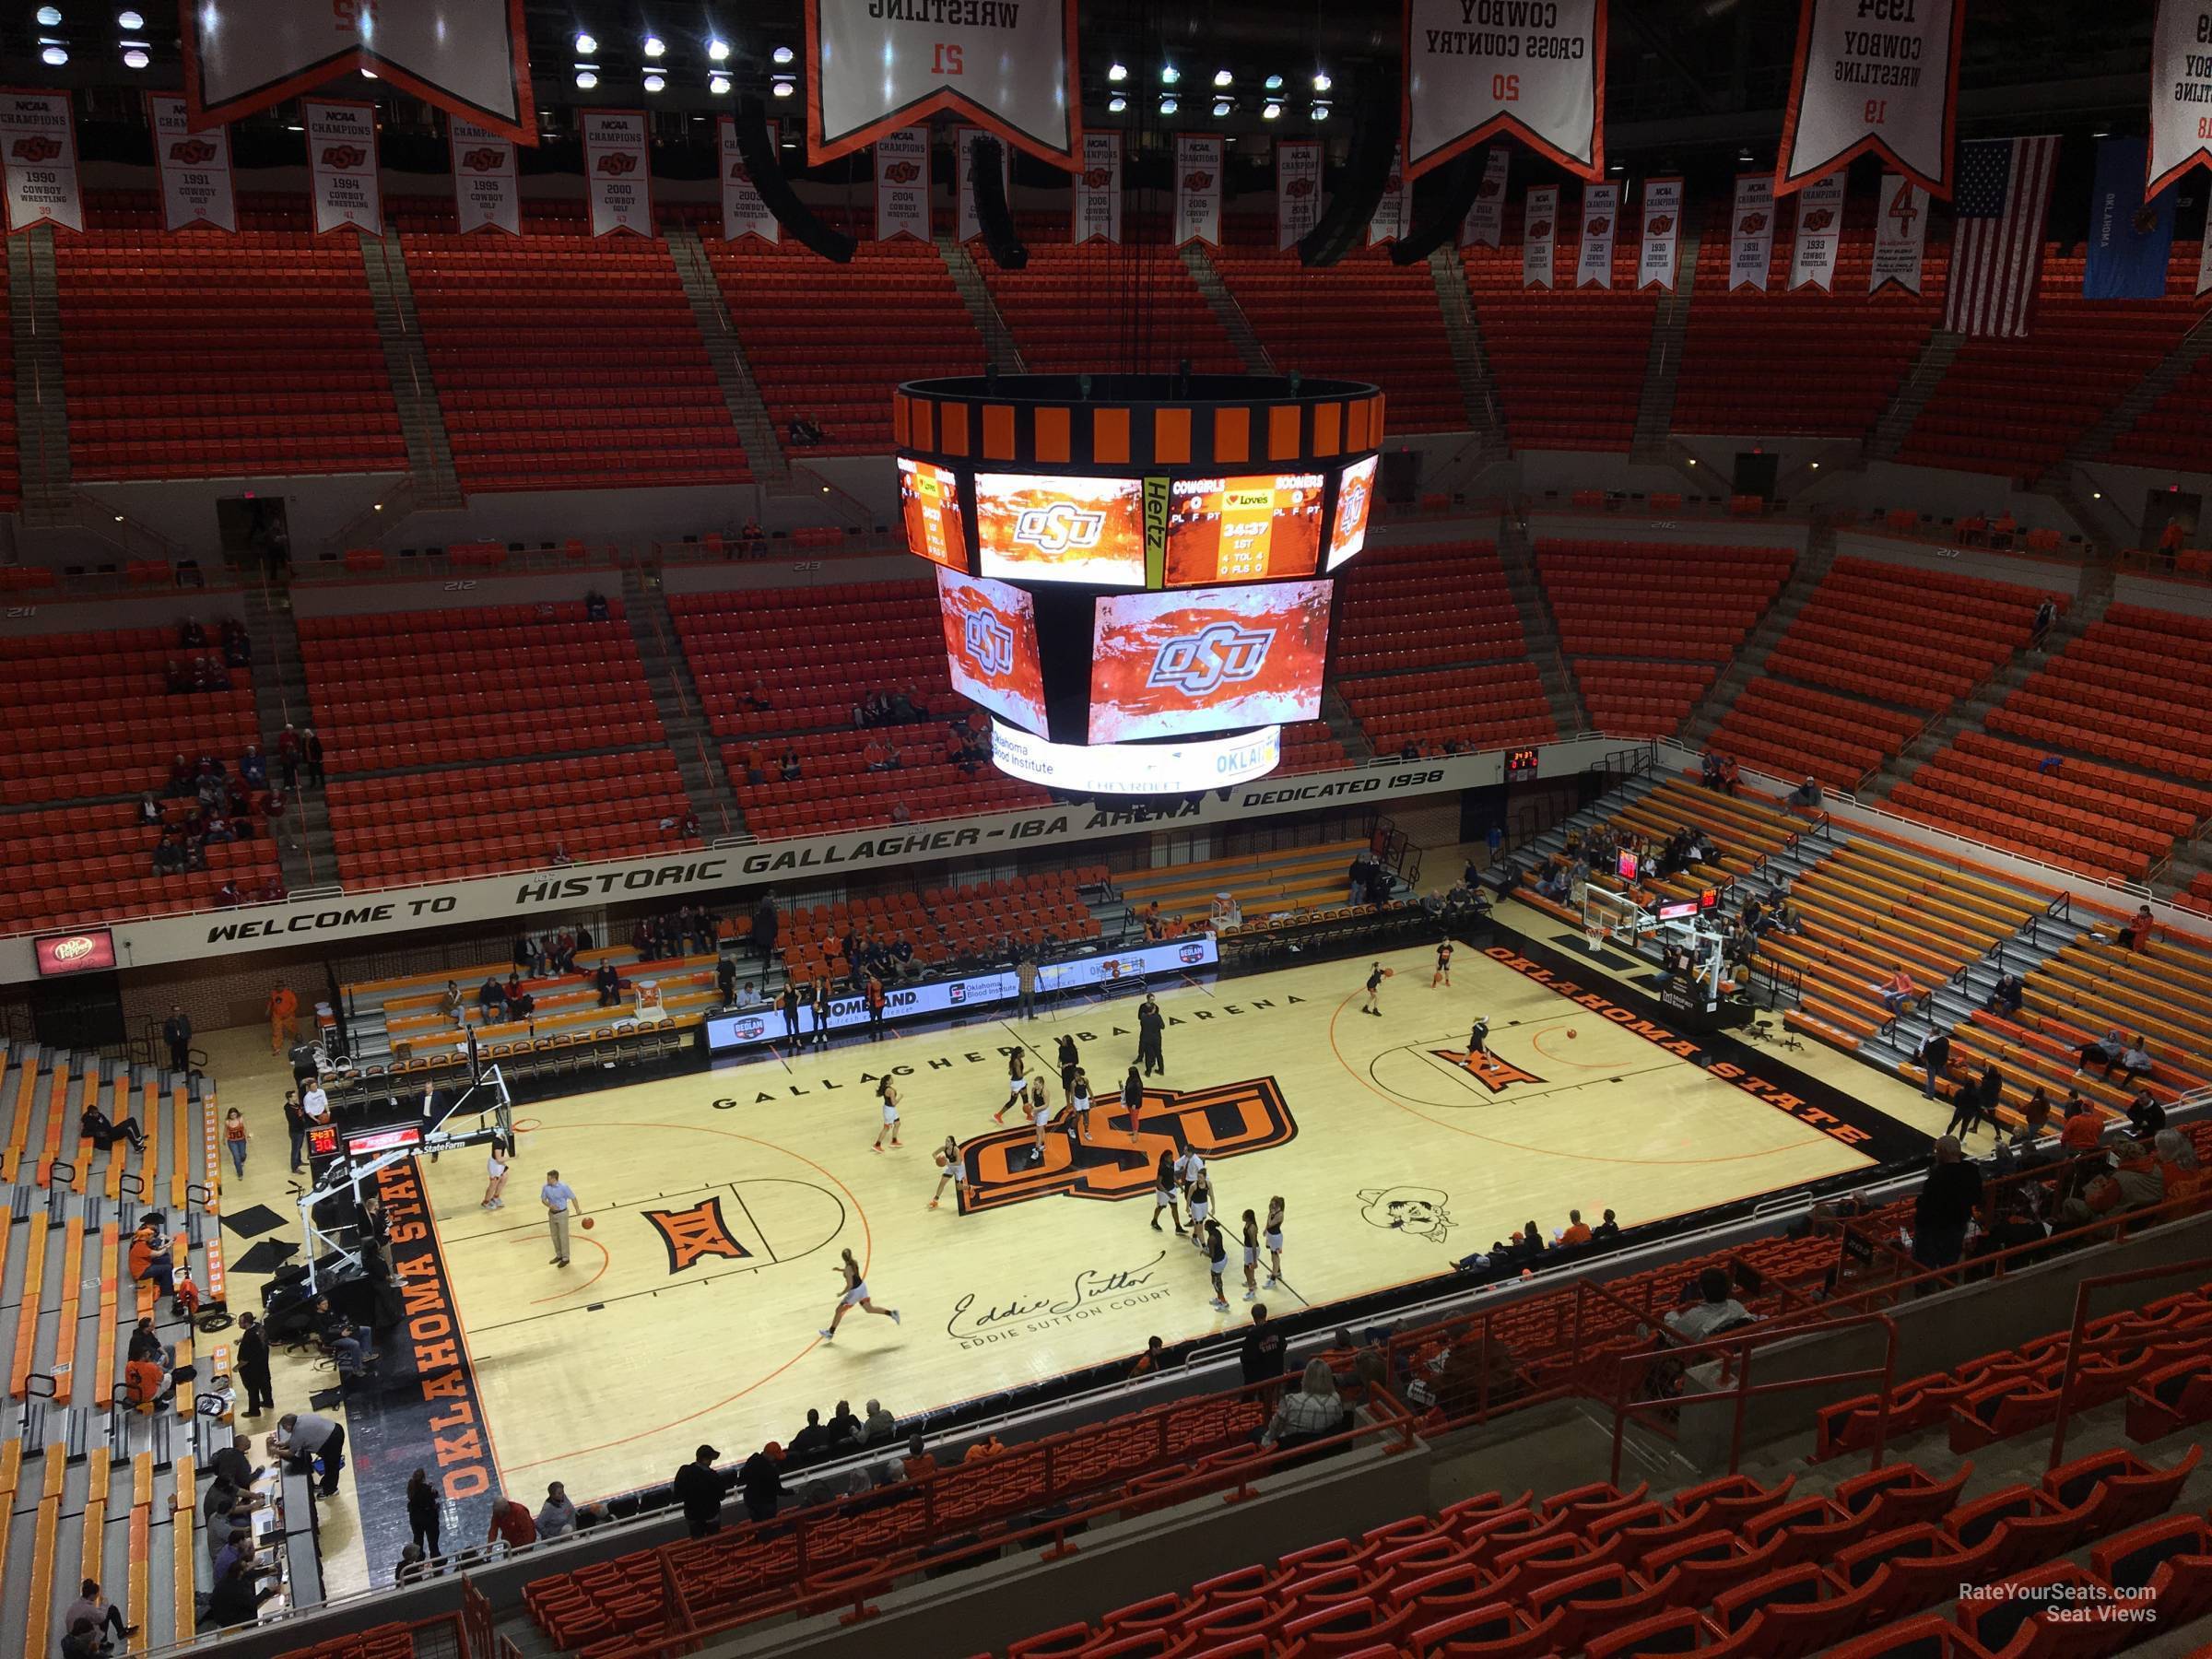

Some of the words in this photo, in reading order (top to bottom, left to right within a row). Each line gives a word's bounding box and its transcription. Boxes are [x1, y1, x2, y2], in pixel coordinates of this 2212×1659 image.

[16, 100, 49, 112] NCAA
[1, 114, 66, 125] CHAMPIONS
[325, 112, 357, 122] NCAA
[312, 123, 371, 135] CHAMPIONS
[601, 121, 629, 130] NCAA
[589, 133, 641, 142] CHAMPIONS
[890, 132, 913, 141] NCAA
[878, 143, 925, 154] CHAMPIONS
[1087, 139, 1108, 148] NCAA
[1189, 144, 1210, 152] NCAA
[26, 171, 55, 183] 1990
[183, 174, 210, 184] 1991
[332, 178, 359, 189] 1994
[473, 181, 499, 191] 1995
[23, 185, 61, 195] COWBOY
[179, 187, 217, 196] COWBOY
[607, 184, 631, 194] 2000
[20, 194, 67, 203] WRESTLING
[329, 191, 364, 200] COWBOY
[470, 193, 503, 202] COWBOY
[892, 192, 914, 202] 2004
[1802, 190, 1841, 200] CHAMPIONS
[327, 200, 369, 208] WRESTLING
[604, 196, 636, 205] COWBOY
[1647, 197, 1680, 207] CHAMPIONS
[735, 203, 766, 212] COWBOY
[889, 203, 917, 211] COWBOY
[734, 211, 769, 219] WRESTLING
[2100, 193, 2115, 248] OKLAHOMA
[1651, 243, 1665, 253] 1930
[1743, 242, 1759, 252] 1931
[1806, 240, 1826, 250] 1933
[1803, 252, 1827, 260] COWBOY
[1172, 478, 1226, 494] COWGIRLS
[1275, 474, 1324, 489] SOONERS
[1292, 491, 1303, 503] 0
[1191, 496, 1203, 509] 0
[1147, 481, 1166, 548] Hertz
[1306, 506, 1320, 514] PT
[1206, 512, 1221, 522] PT
[794, 560, 822, 571] 213
[444, 580, 477, 591] 212
[6, 607, 36, 618] 211
[965, 607, 1013, 677] OSU
[1146, 621, 1277, 696] OSU
[1011, 754, 1054, 775] Institute
[515, 859, 726, 903] HISTORIC
[743, 817, 1067, 874] GALLAGHER-IBA
[1243, 779, 1380, 806] DEDICATED
[1388, 770, 1444, 789] 1938
[207, 903, 395, 943] WELCOME
[408, 896, 456, 915] TO
[966, 981, 1001, 993] Oklahoma
[968, 988, 987, 998] Blood
[1170, 994, 1307, 1025] ARENA
[1483, 947, 1702, 1057] OKLAHOMA
[1707, 1061, 1873, 1144] STATE
[959, 1076, 1299, 1217] OSU
[947, 1293, 1050, 1339] Eddie
[1049, 1250, 1167, 1314] Sutton
[960, 1328, 1019, 1350] EDDIE
[1027, 1306, 1102, 1332] SUTTON
[1110, 1288, 1171, 1311] COURT
[396, 1253, 490, 1500] OKLAHOMA
